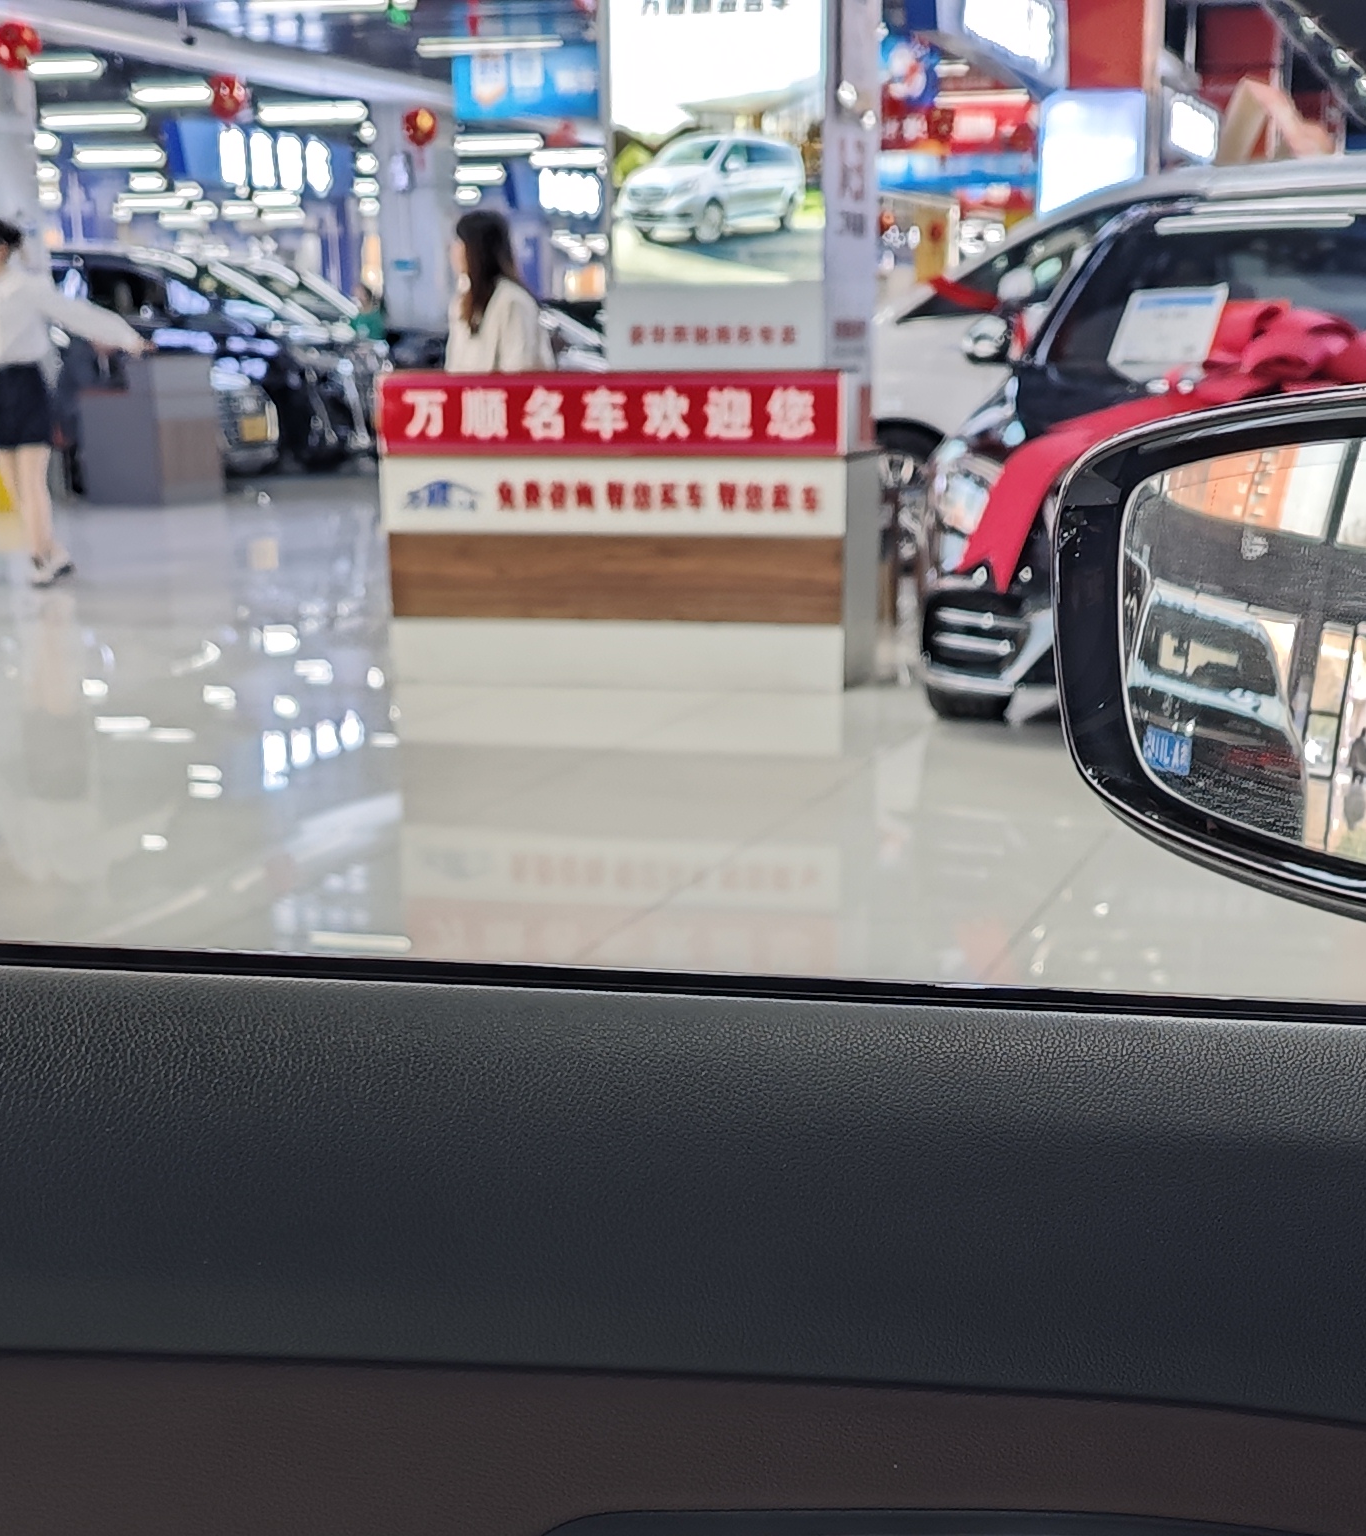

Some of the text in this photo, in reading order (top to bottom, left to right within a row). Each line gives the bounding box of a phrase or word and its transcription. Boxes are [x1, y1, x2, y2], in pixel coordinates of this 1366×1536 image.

[403, 386, 816, 440] 万顺名车欢迎您
